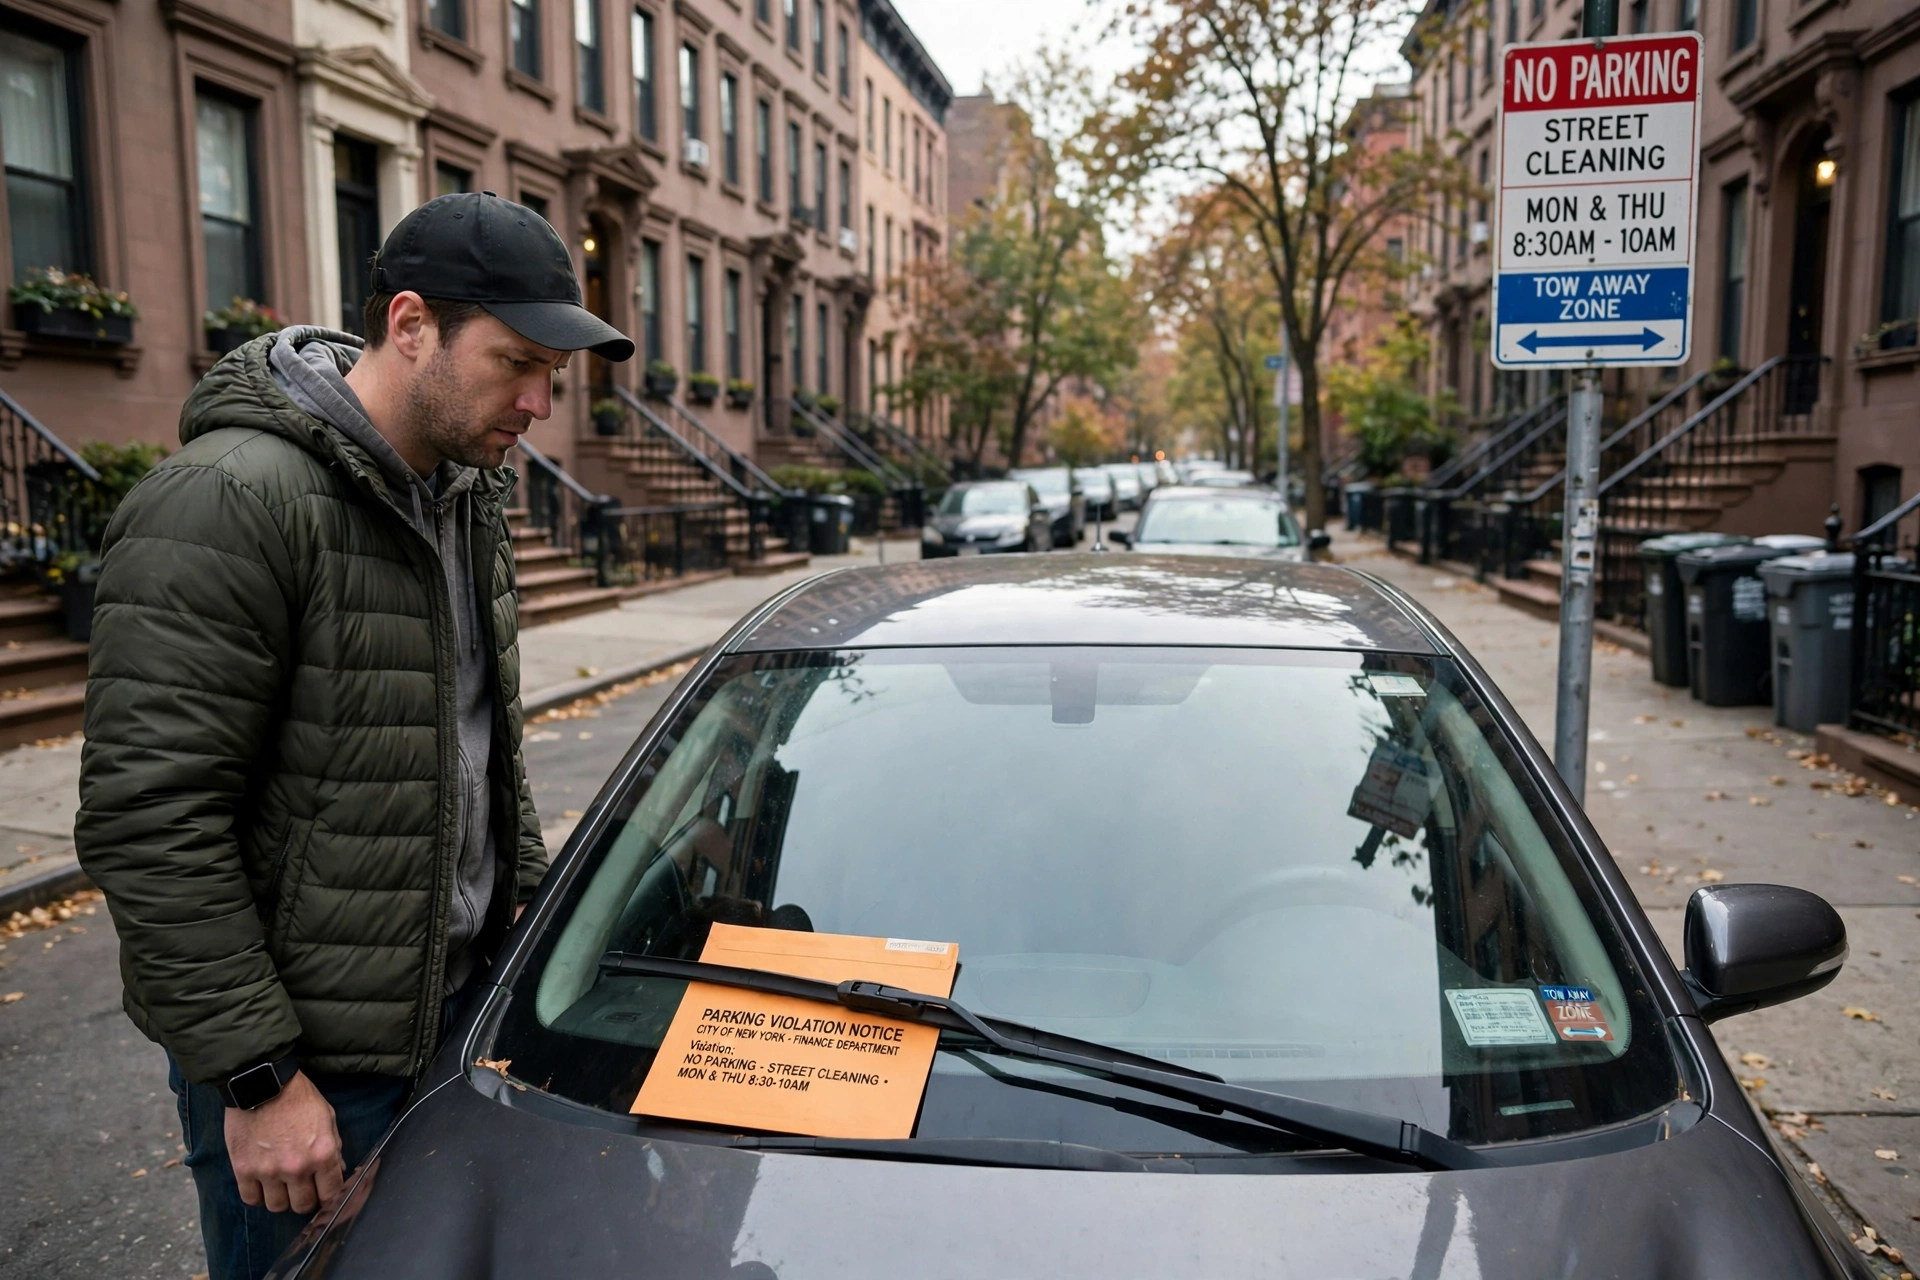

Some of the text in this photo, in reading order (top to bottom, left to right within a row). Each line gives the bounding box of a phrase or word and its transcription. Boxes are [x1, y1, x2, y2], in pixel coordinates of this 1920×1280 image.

[1513, 47, 1690, 103] NO PARKING
[1544, 113, 1650, 143] STREET
[1526, 145, 1665, 176] CLEANING
[1526, 191, 1665, 224] MON & THU
[1513, 229, 1595, 257] 8:30AM
[1620, 226, 1676, 254] 10AM
[1533, 273, 1651, 298] TOW AWAY
[1559, 298, 1621, 320] ZONE
[696, 1024, 720, 1036] CITY
[719, 1026, 735, 1037] OF
[734, 1028, 758, 1040] NEW
[759, 1031, 786, 1043] YORK
[793, 1034, 835, 1048] FINANCE
[836, 1039, 901, 1056] DEPARTMENT
[701, 1008, 905, 1042] PARKING VIOLATION NOTICE
[677, 1067, 708, 1080] MON
[708, 1070, 718, 1081] &
[721, 1071, 747, 1084] THU
[683, 1053, 703, 1065] NO
[704, 1055, 757, 1071] PARKING
[767, 1062, 816, 1078] STREET
[817, 1068, 880, 1086] CLEANING
